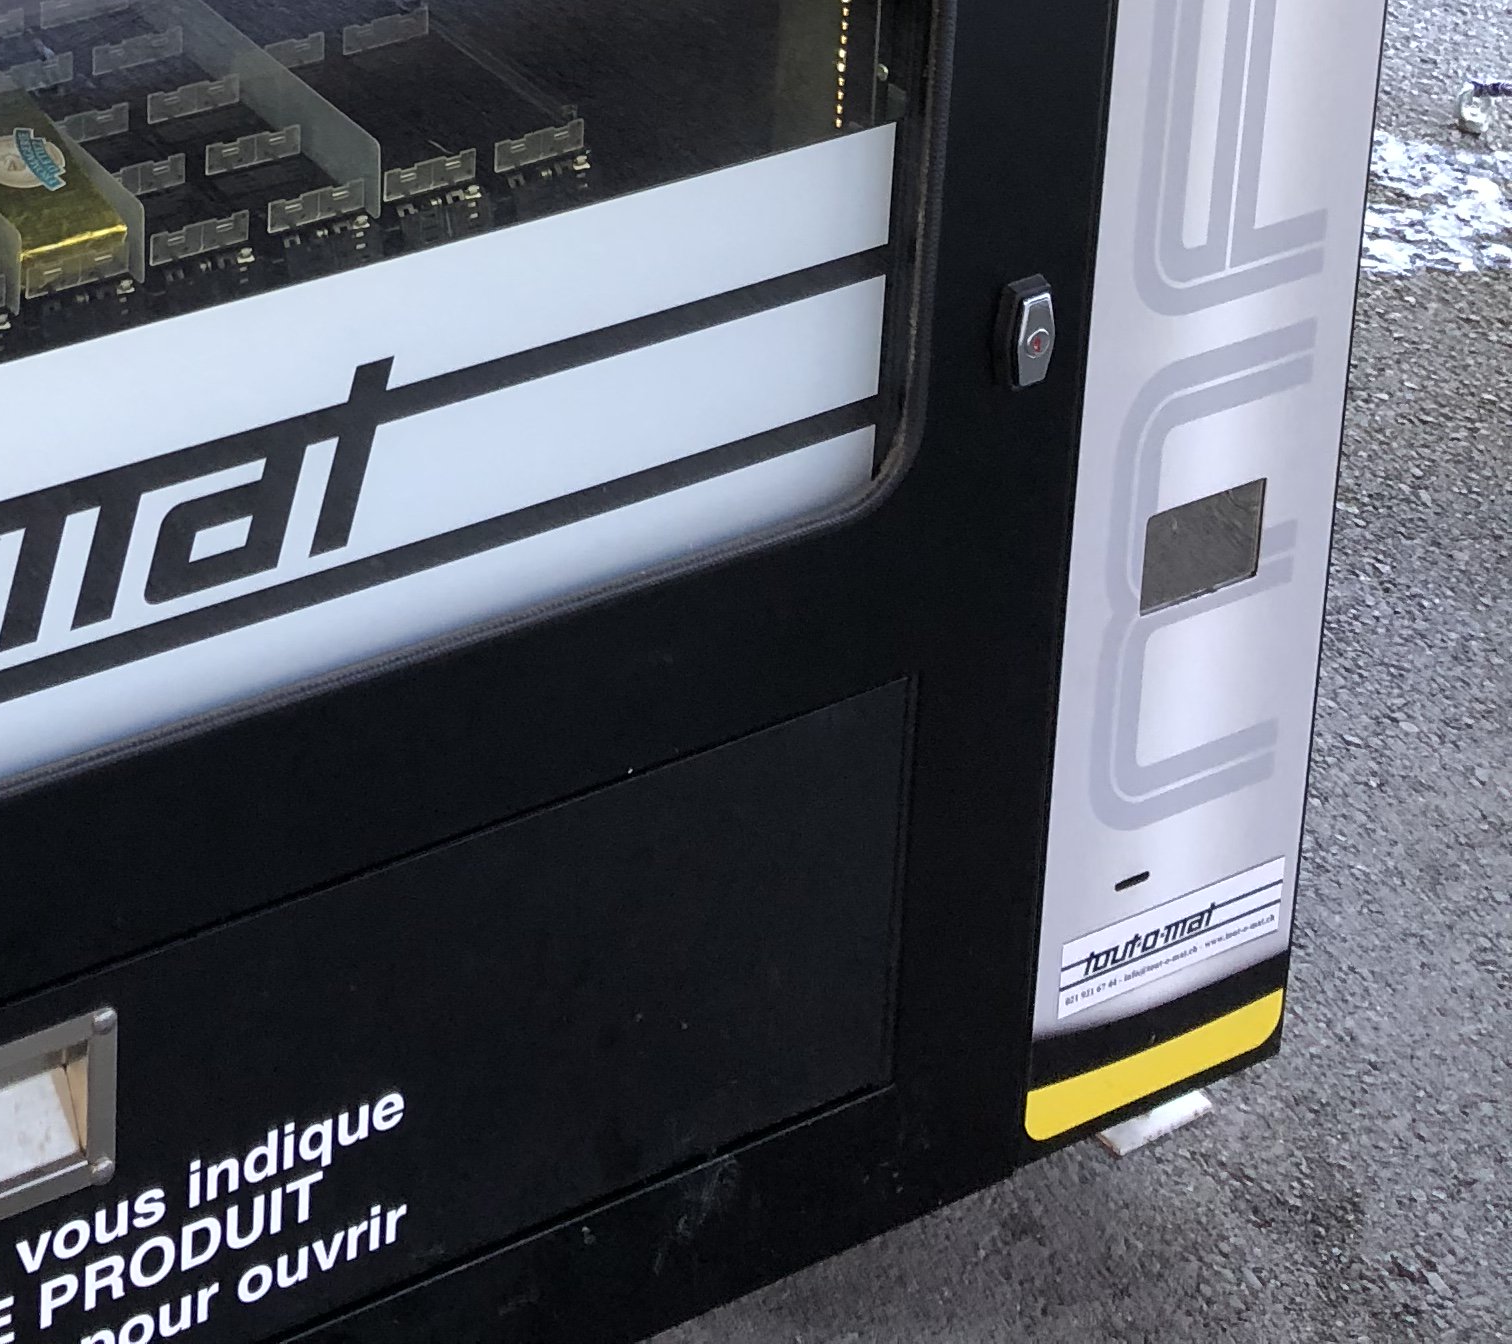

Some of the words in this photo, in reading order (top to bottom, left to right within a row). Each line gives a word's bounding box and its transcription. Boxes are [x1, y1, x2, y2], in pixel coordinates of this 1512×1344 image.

[15, 1188, 167, 1274] vous
[187, 1090, 406, 1211] indique
[38, 1172, 325, 1330] PRODUIT
[235, 1201, 408, 1305] ouvrir
